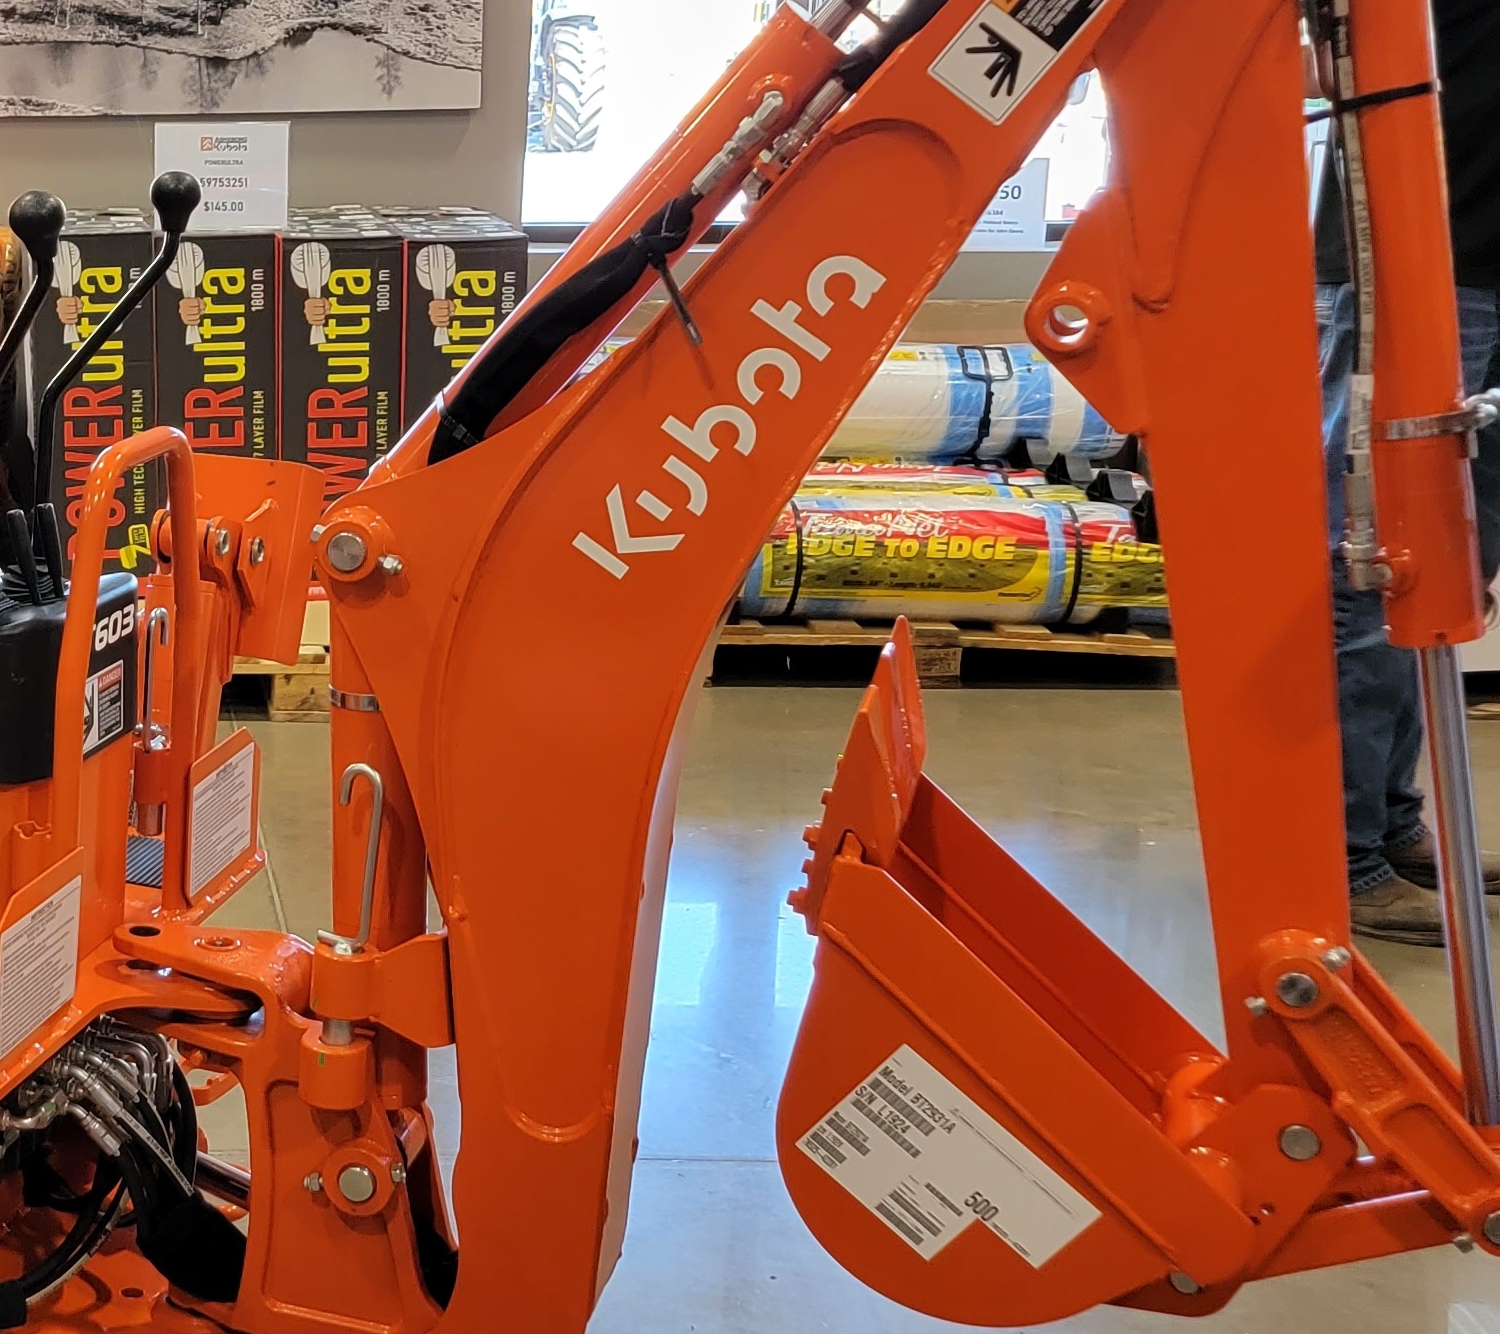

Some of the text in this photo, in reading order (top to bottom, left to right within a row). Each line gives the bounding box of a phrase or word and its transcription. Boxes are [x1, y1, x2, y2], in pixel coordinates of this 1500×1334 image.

[204, 201, 244, 212] $145.00
[251, 269, 264, 312] 1800 m
[377, 269, 390, 313] 1800 m
[501, 271, 516, 314] 1800 m
[441, 270, 497, 368] ltra
[132, 389, 144, 414] FILM
[253, 390, 265, 414] FILM
[253, 417, 265, 449] LAYER
[376, 391, 389, 452] LAYER FILM
[571, 255, 886, 580] Kubota
[133, 464, 145, 491] TEC
[134, 494, 146, 514] HIGH
[786, 533, 1019, 560] EDGE TO EDGE
[1090, 542, 1164, 563] EDG
[93, 603, 135, 652] 603
[101, 668, 122, 687] DANGER
[855, 1085, 878, 1106] S/N
[879, 1065, 914, 1096] Model
[964, 1190, 999, 1221] 500
